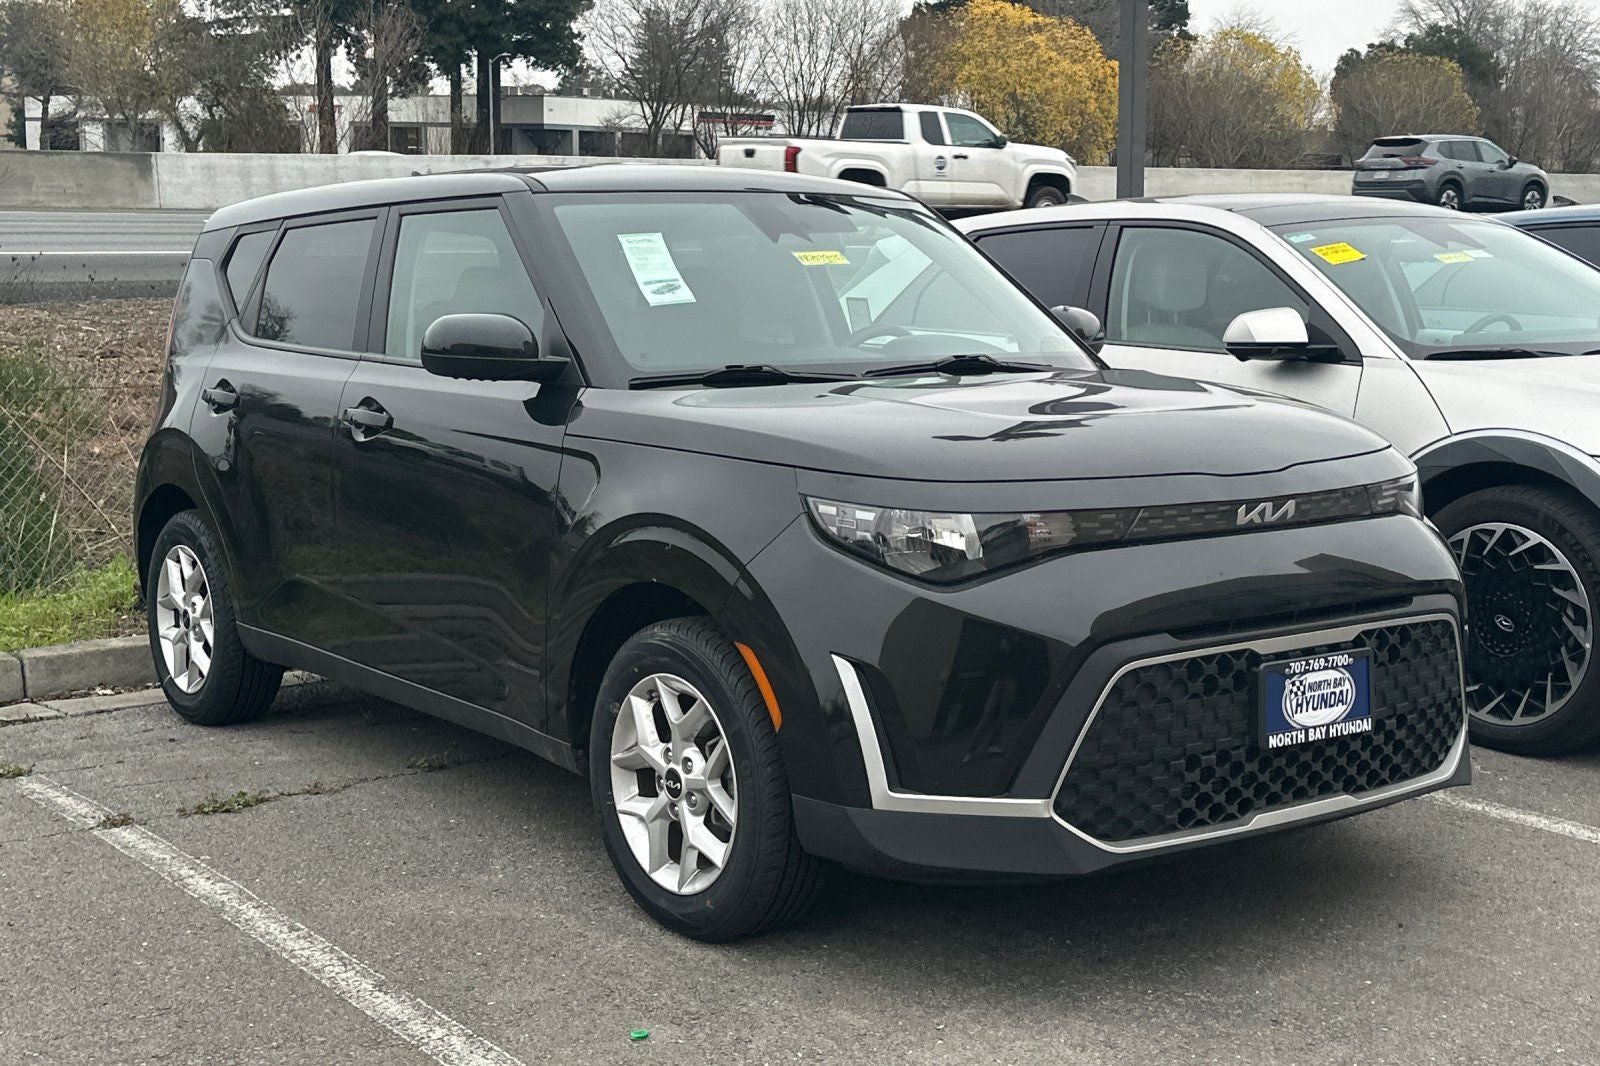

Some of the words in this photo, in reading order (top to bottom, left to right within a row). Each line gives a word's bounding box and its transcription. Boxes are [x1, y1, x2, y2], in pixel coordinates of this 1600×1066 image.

[1236, 499, 1296, 525] KIA
[1289, 654, 1349, 674] 707-769-7700
[1307, 678, 1332, 693] NORTH
[1332, 676, 1347, 690] BAY
[1294, 688, 1349, 714] HYUNDAI
[1268, 730, 1305, 748] NORTH
[1308, 726, 1327, 742] BAY
[1329, 717, 1372, 738] HYUNDAI
